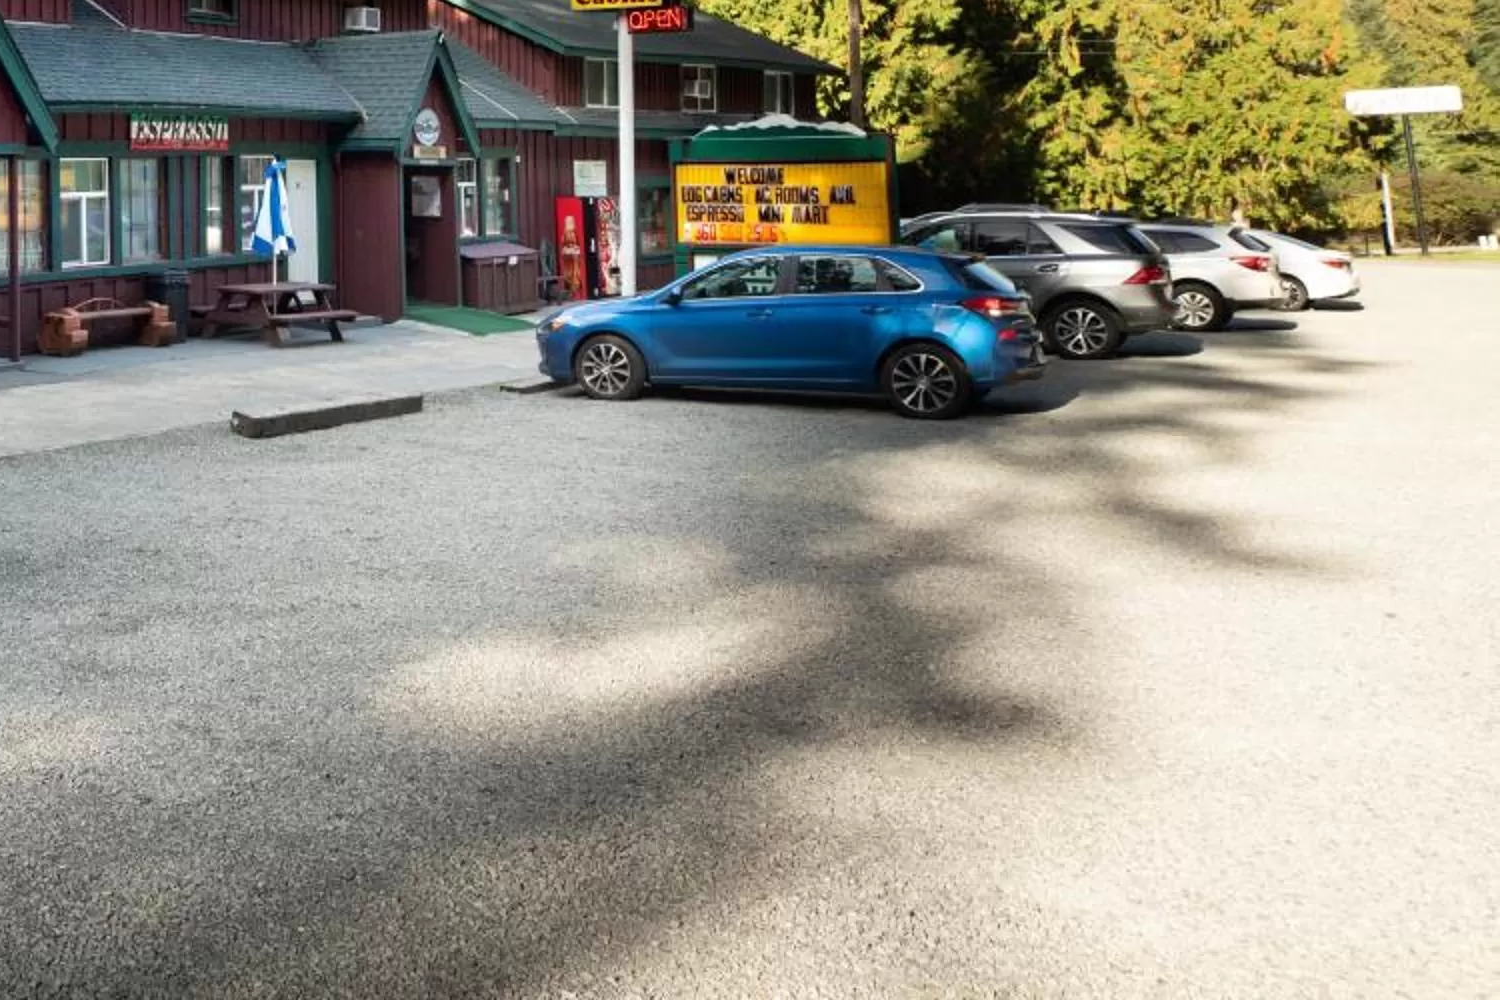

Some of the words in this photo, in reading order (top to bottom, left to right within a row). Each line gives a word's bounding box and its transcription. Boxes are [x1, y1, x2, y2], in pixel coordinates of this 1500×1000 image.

[628, 8, 685, 31] OPEN
[137, 115, 226, 144] ESPRESSO
[724, 167, 784, 185] WELCOME
